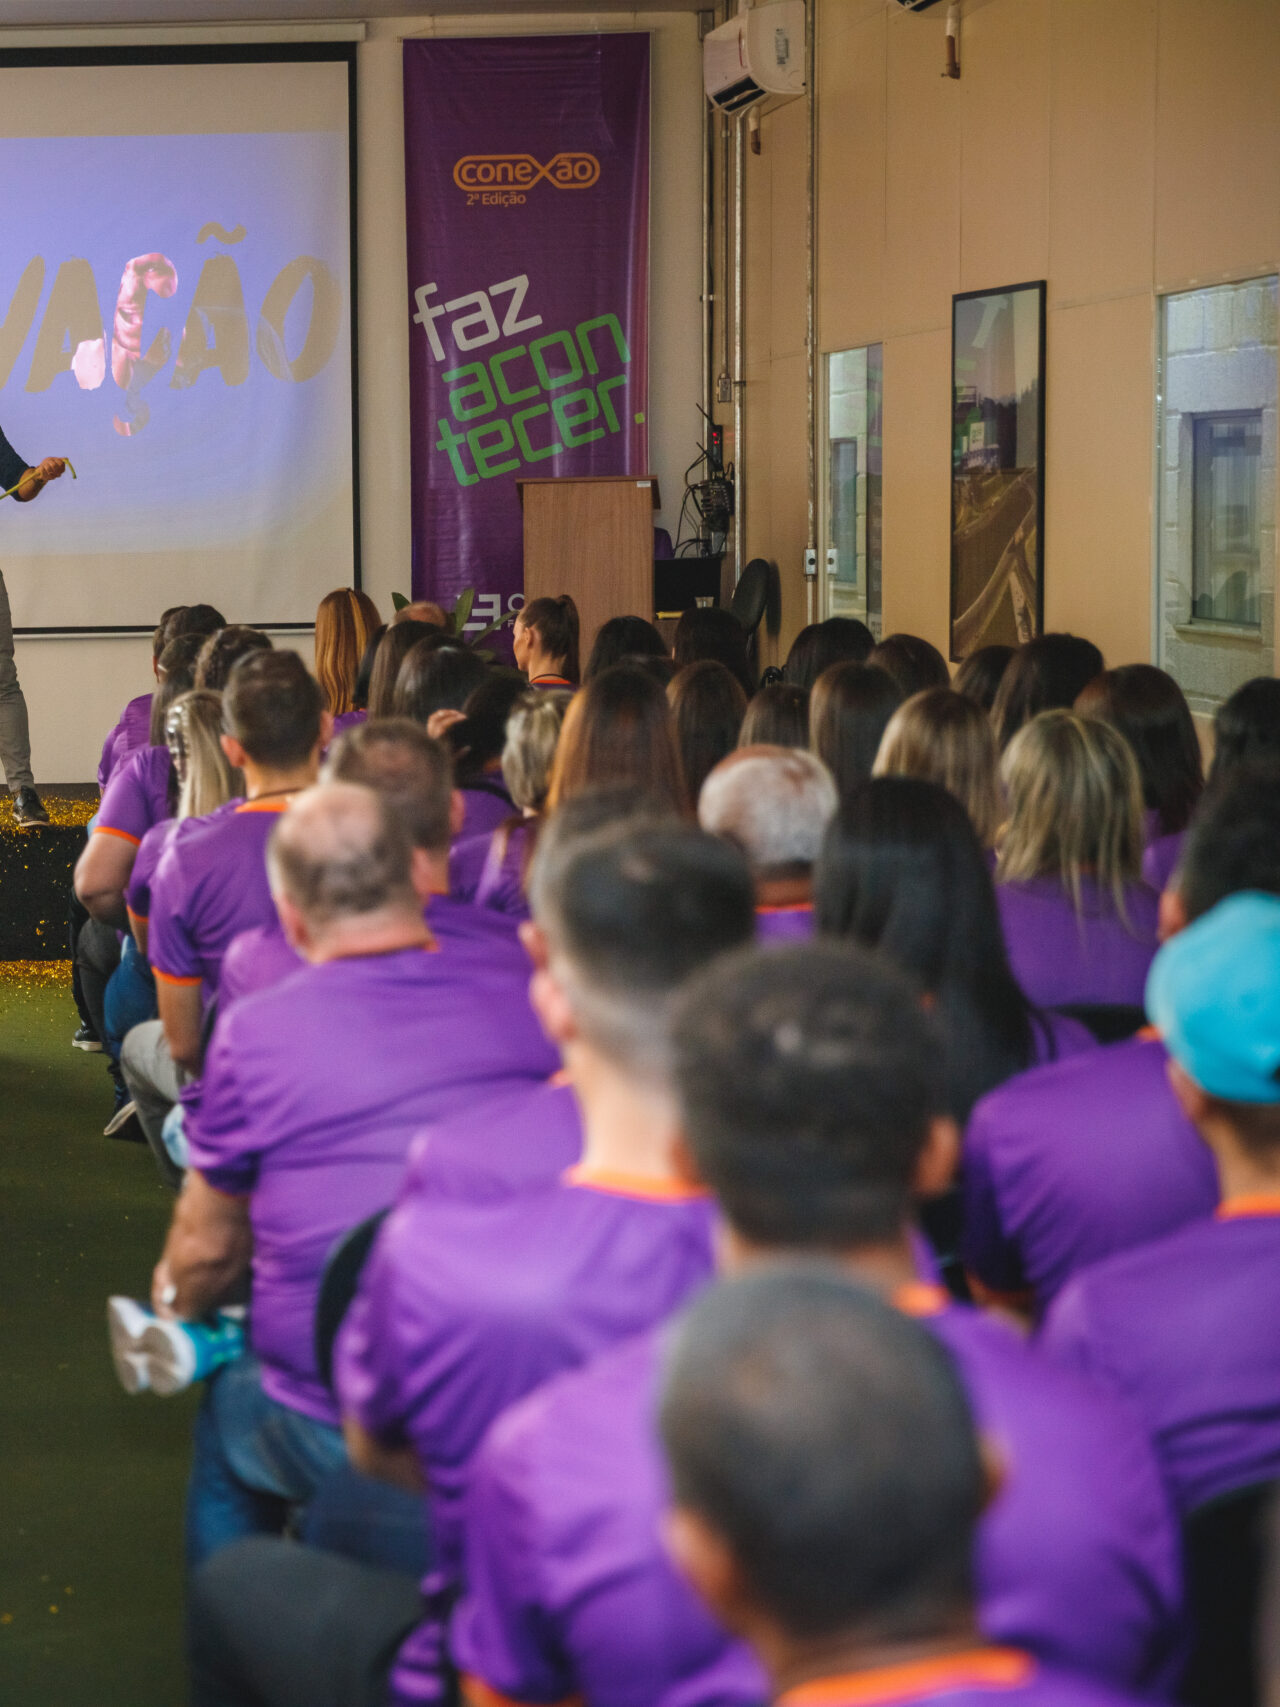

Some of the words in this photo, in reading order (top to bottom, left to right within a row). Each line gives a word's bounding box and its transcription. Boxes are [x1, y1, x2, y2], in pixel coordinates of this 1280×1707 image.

[482, 191, 526, 207] Edição
[413, 274, 543, 362] faz
[441, 312, 632, 422] acon
